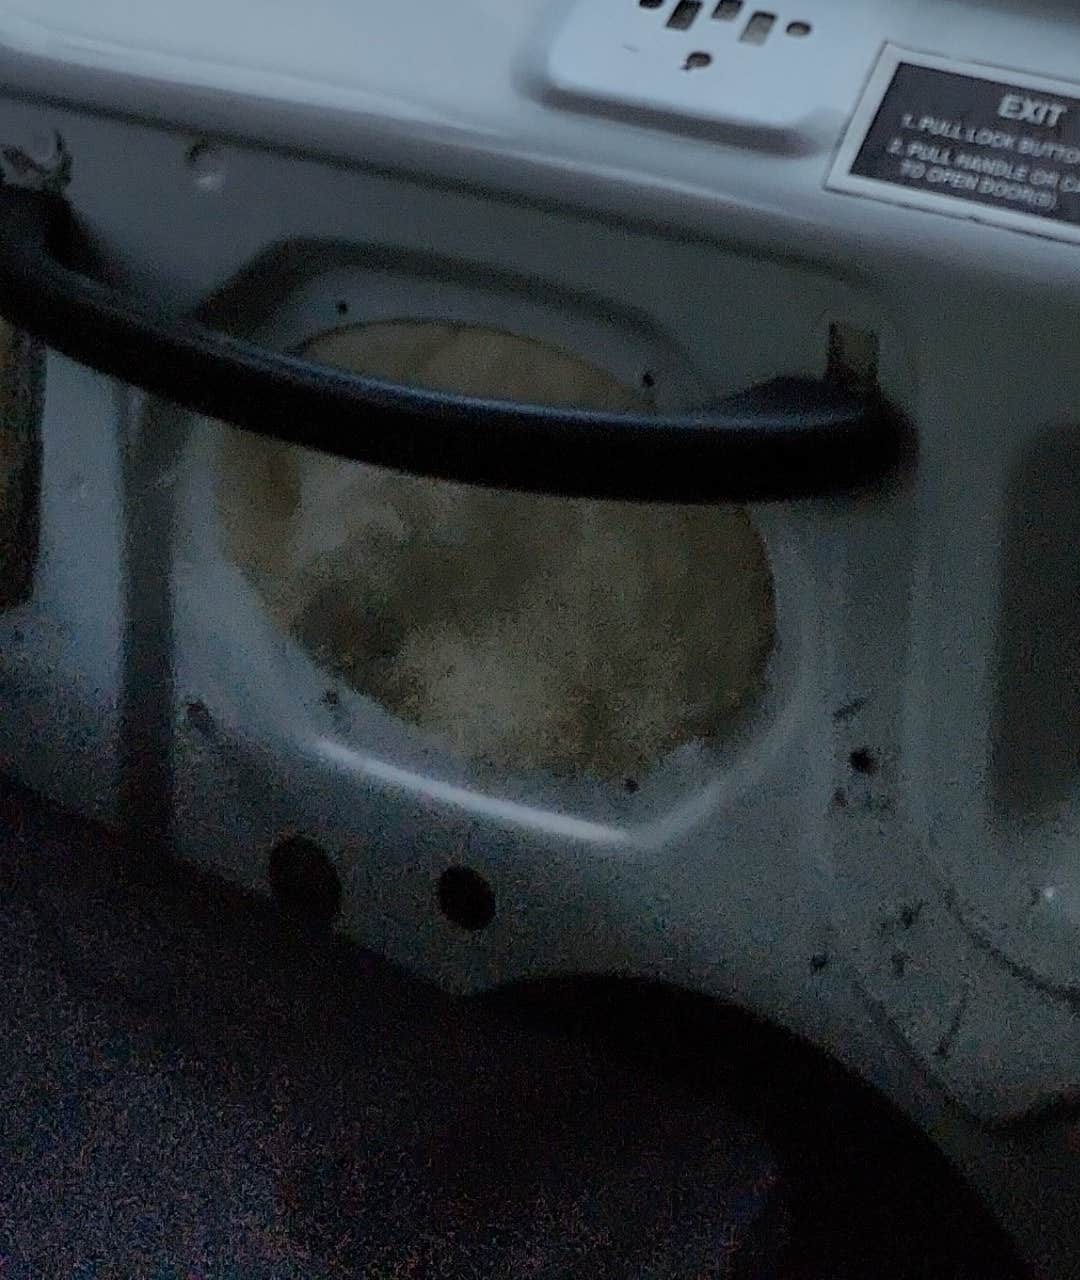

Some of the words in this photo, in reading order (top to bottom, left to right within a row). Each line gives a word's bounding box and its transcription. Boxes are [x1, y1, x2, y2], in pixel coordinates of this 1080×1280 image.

[998, 92, 1068, 128] EXIT
[917, 115, 961, 140] PULL
[963, 127, 1015, 149] LOCK
[900, 159, 925, 179] TO
[925, 166, 979, 190] OPEN
[906, 141, 950, 166] PULL
[952, 154, 1029, 182] HANDLE
